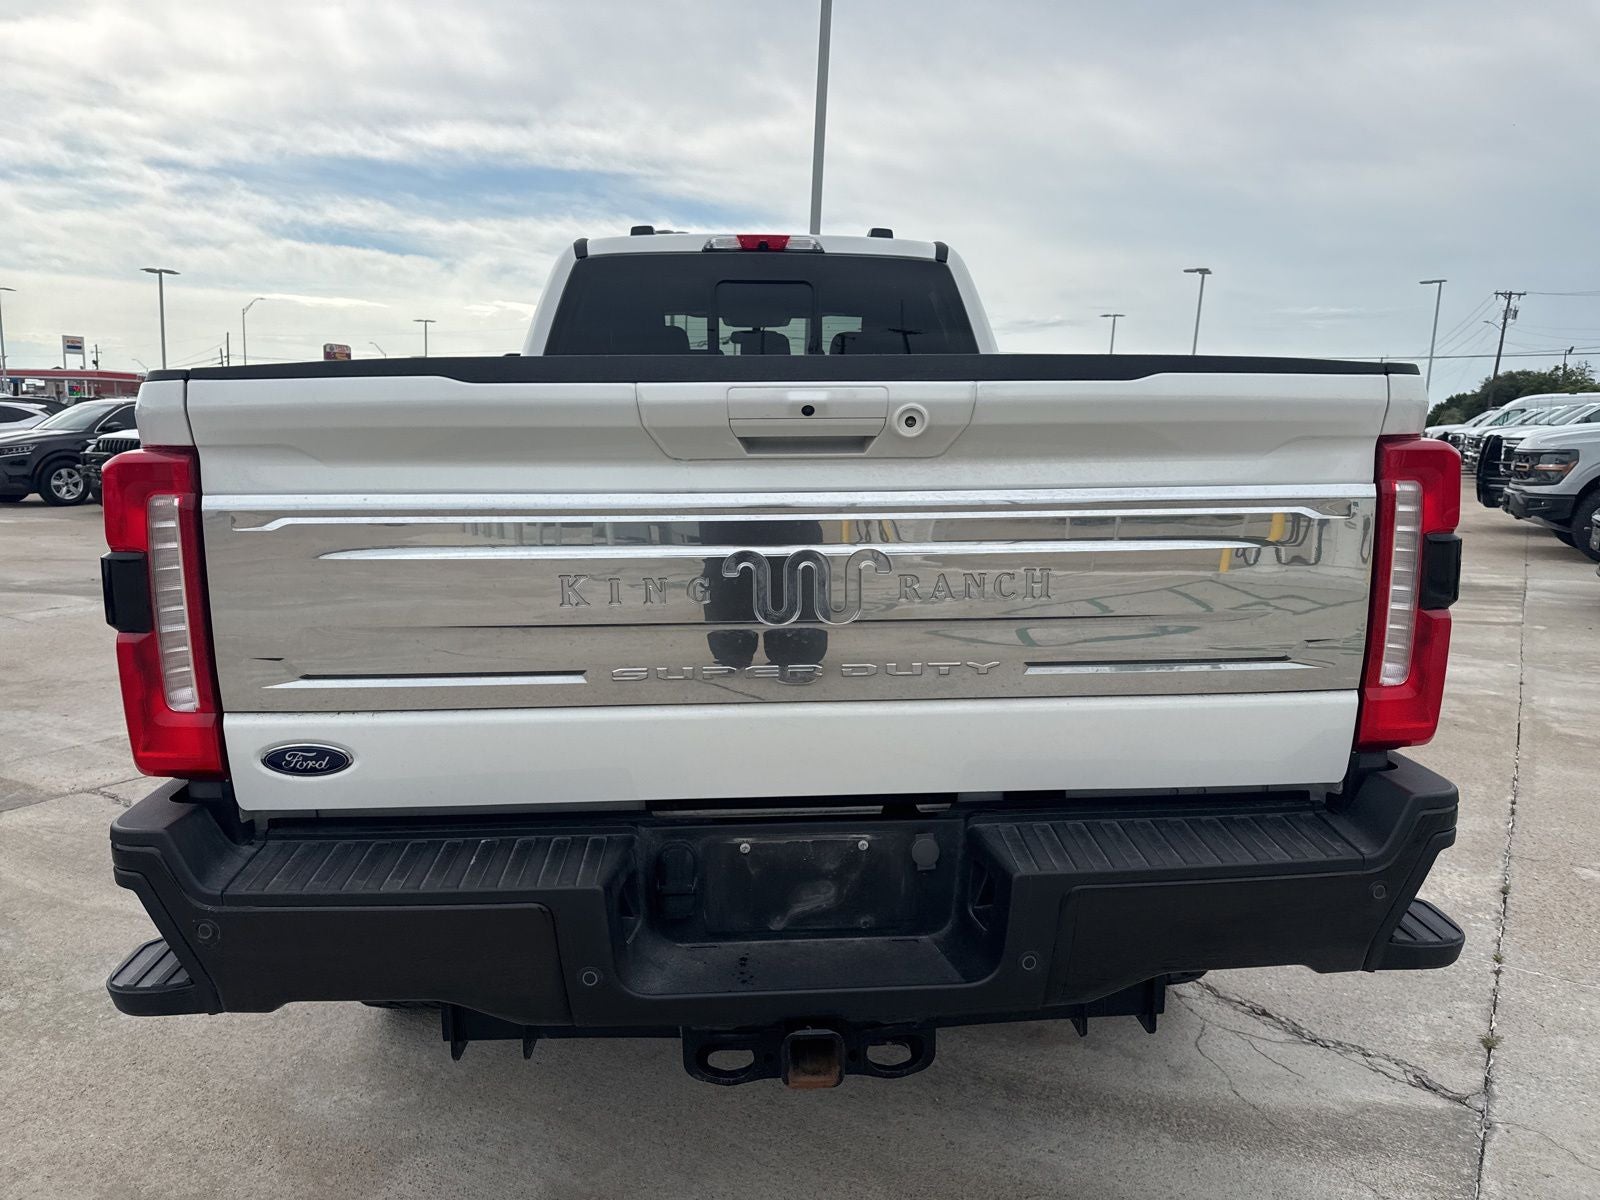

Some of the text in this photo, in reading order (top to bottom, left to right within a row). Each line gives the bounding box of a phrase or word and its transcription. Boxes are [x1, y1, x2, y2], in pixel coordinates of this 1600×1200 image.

[558, 567, 1052, 608] KING RANCH
[611, 661, 1000, 681] SUPER DUTY
[282, 751, 330, 770] Ford
